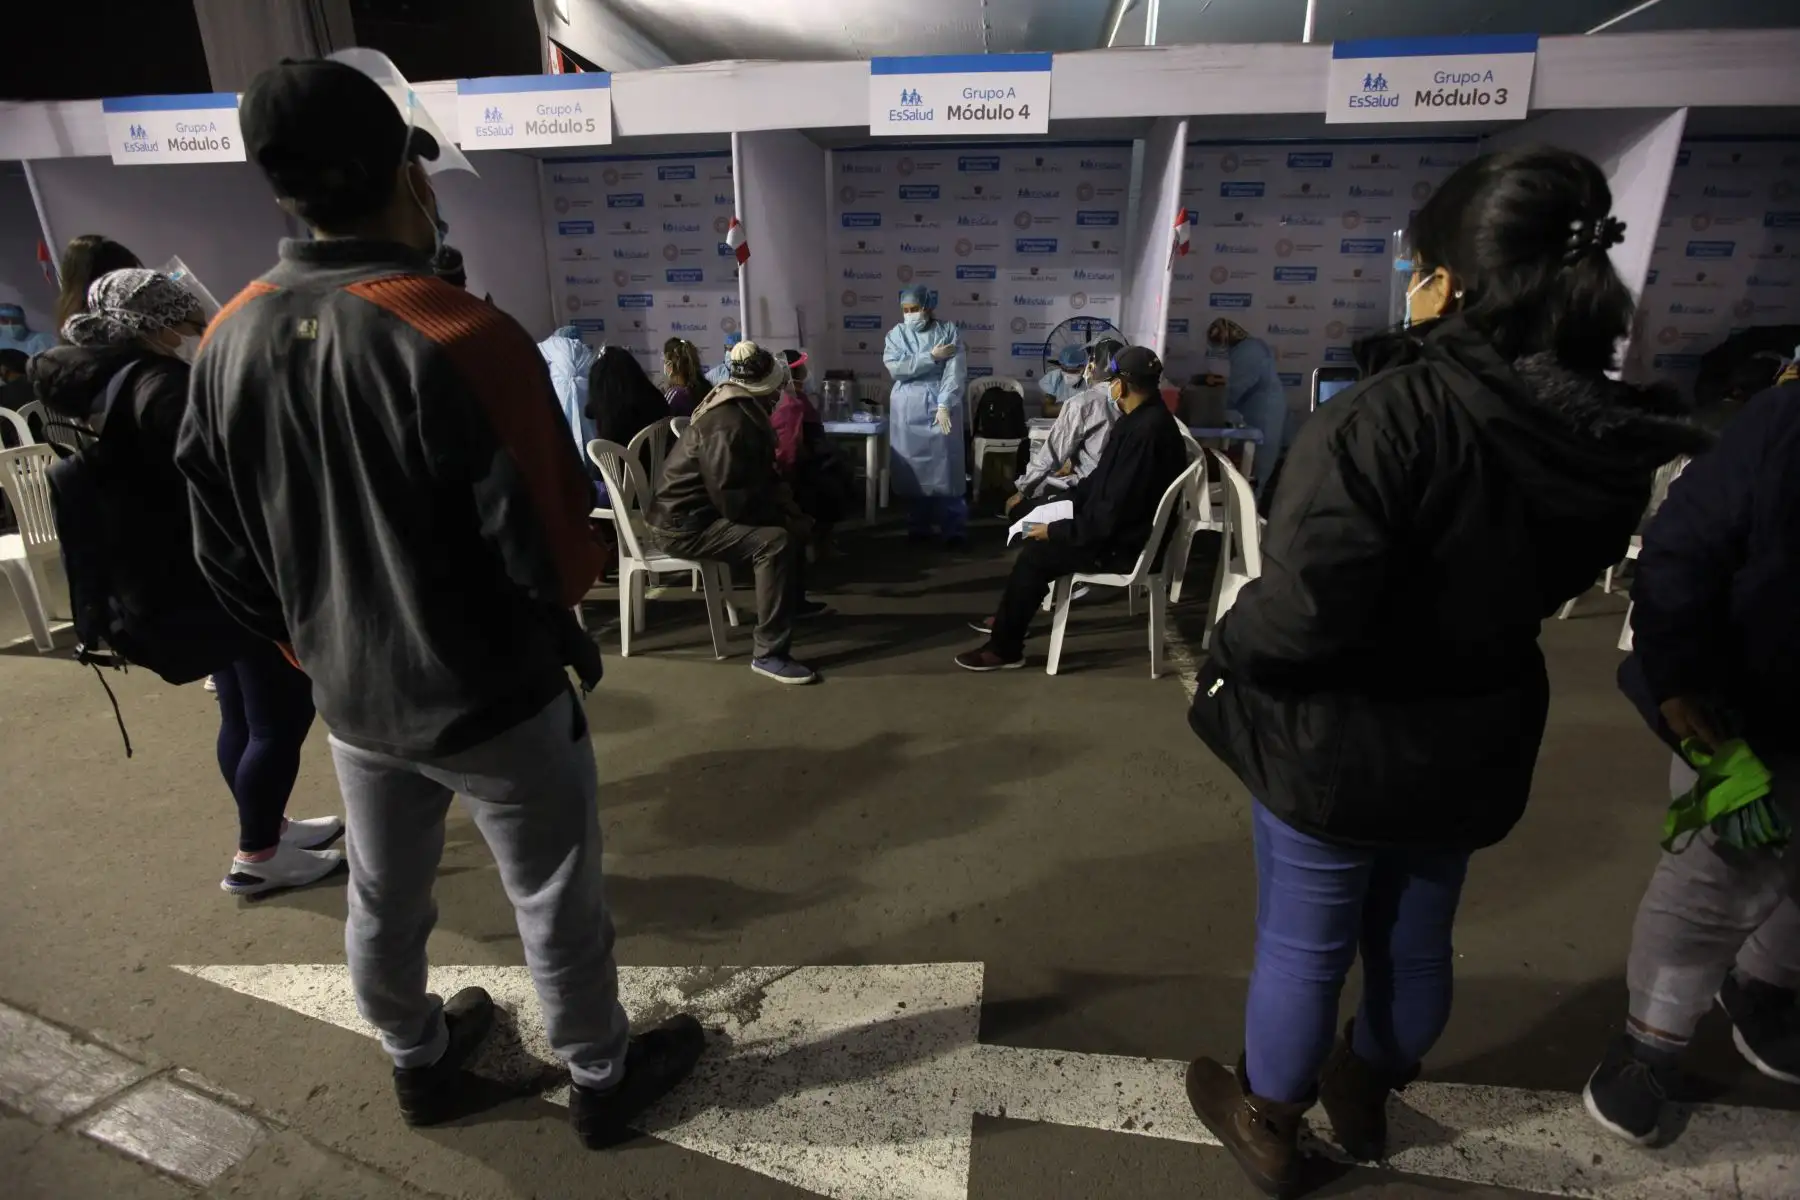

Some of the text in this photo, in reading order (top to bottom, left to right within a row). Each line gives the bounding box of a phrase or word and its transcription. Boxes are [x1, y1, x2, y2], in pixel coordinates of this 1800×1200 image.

[1433, 70, 1494, 86] Grupo A
[962, 87, 1016, 101] Grupo A
[1348, 94, 1399, 108] EsSalud
[1414, 88, 1508, 107] Módulo 3
[536, 102, 582, 117] Grupo A
[889, 108, 934, 121] EsSalud
[947, 104, 1031, 121] Módulo 4
[175, 121, 217, 135] Grupo A
[475, 124, 514, 137] EsSalud
[525, 118, 595, 136] Módulo 5
[124, 142, 159, 152] EsSalud
[167, 136, 231, 151] Módulo 6
